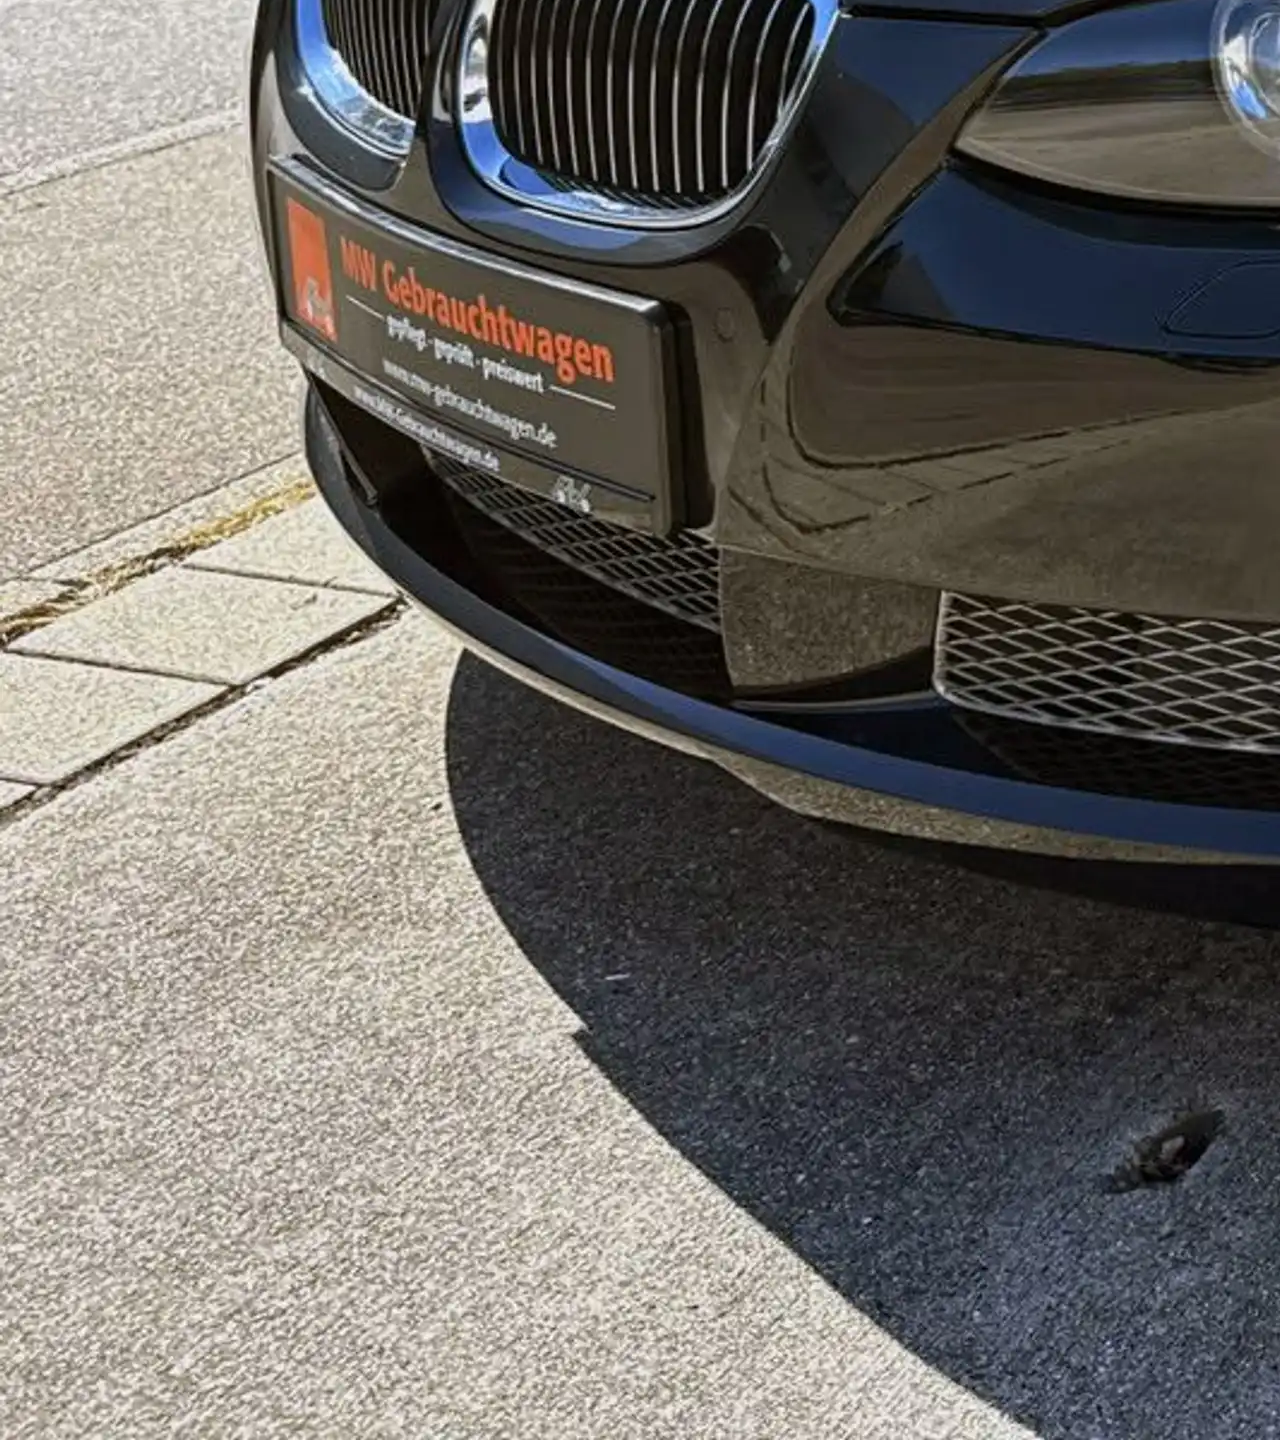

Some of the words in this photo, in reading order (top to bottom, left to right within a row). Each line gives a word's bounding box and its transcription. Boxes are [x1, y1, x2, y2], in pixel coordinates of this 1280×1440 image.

[339, 235, 378, 291] MW
[382, 260, 615, 385] Gebrauchtwagen
[482, 356, 545, 394] preiswert
